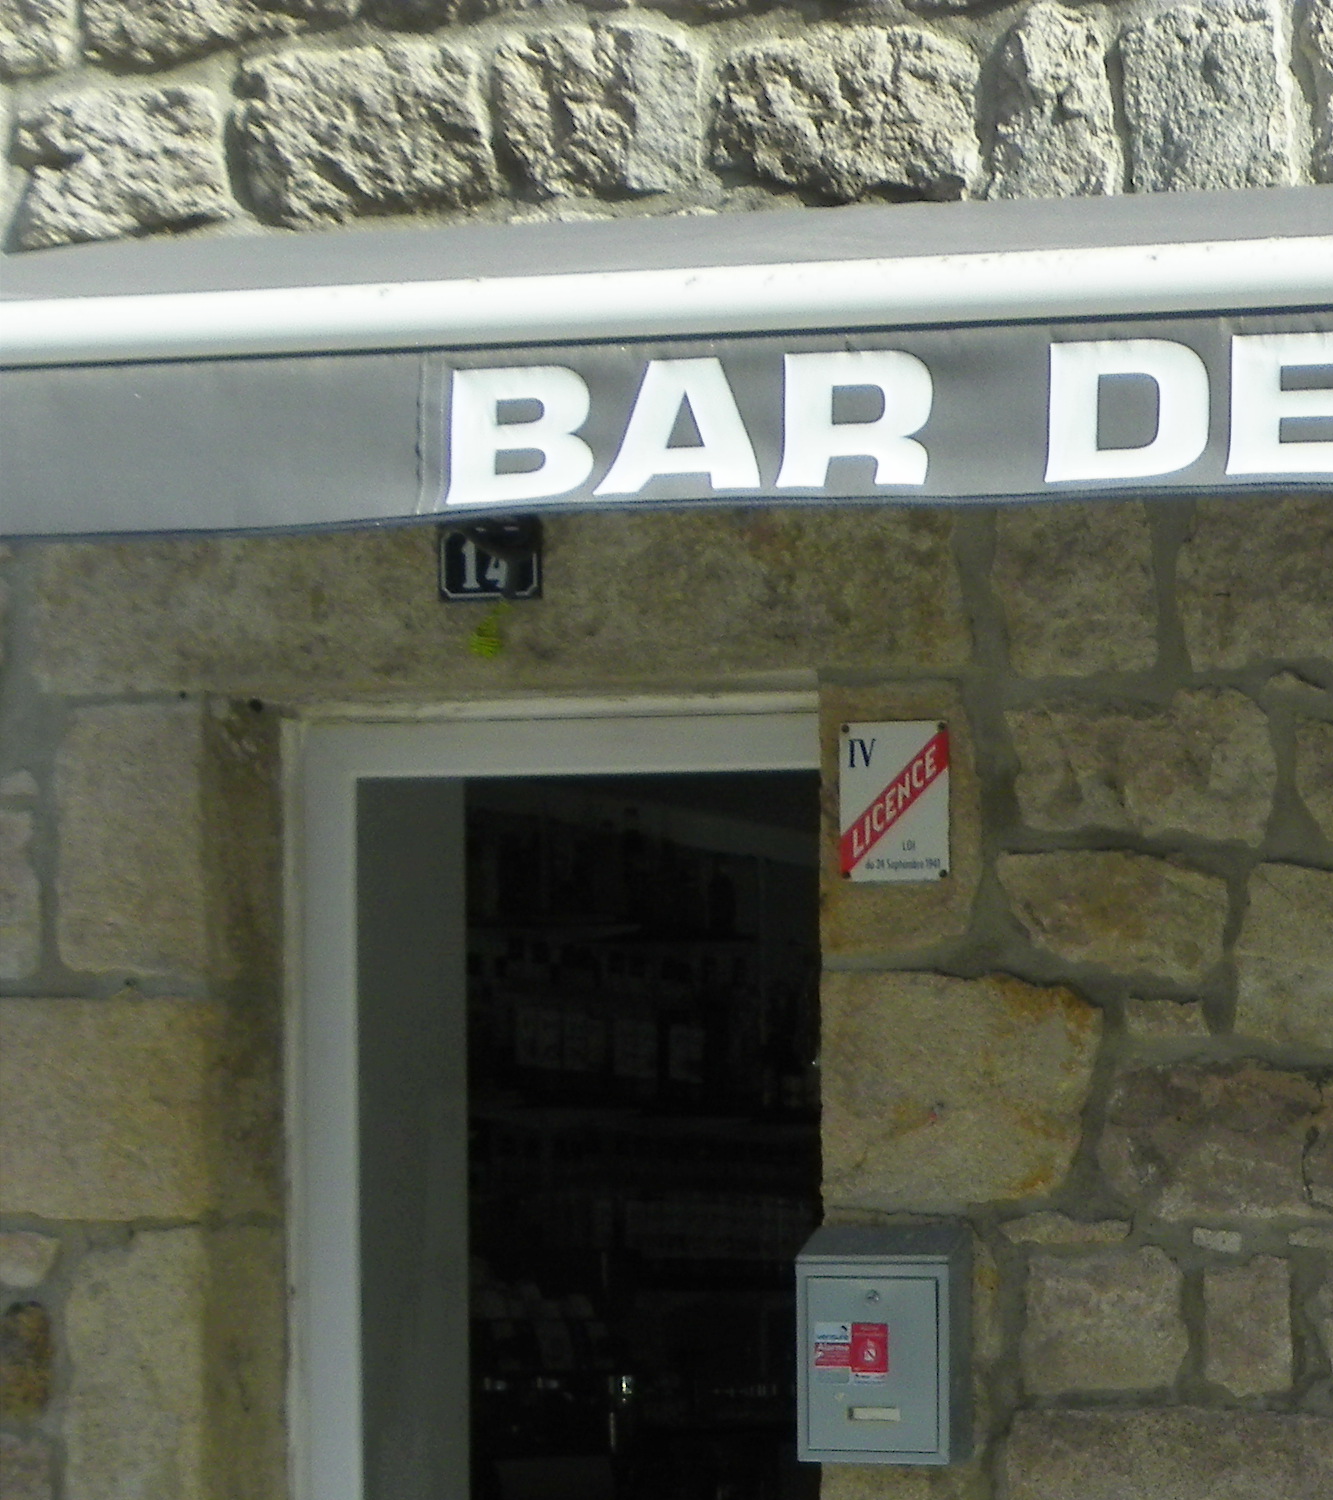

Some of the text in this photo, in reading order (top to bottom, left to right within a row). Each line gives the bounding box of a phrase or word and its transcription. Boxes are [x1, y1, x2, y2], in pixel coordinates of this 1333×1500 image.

[446, 350, 934, 504] BAR
[849, 738, 876, 768] IV
[851, 745, 938, 858] LICENCE
